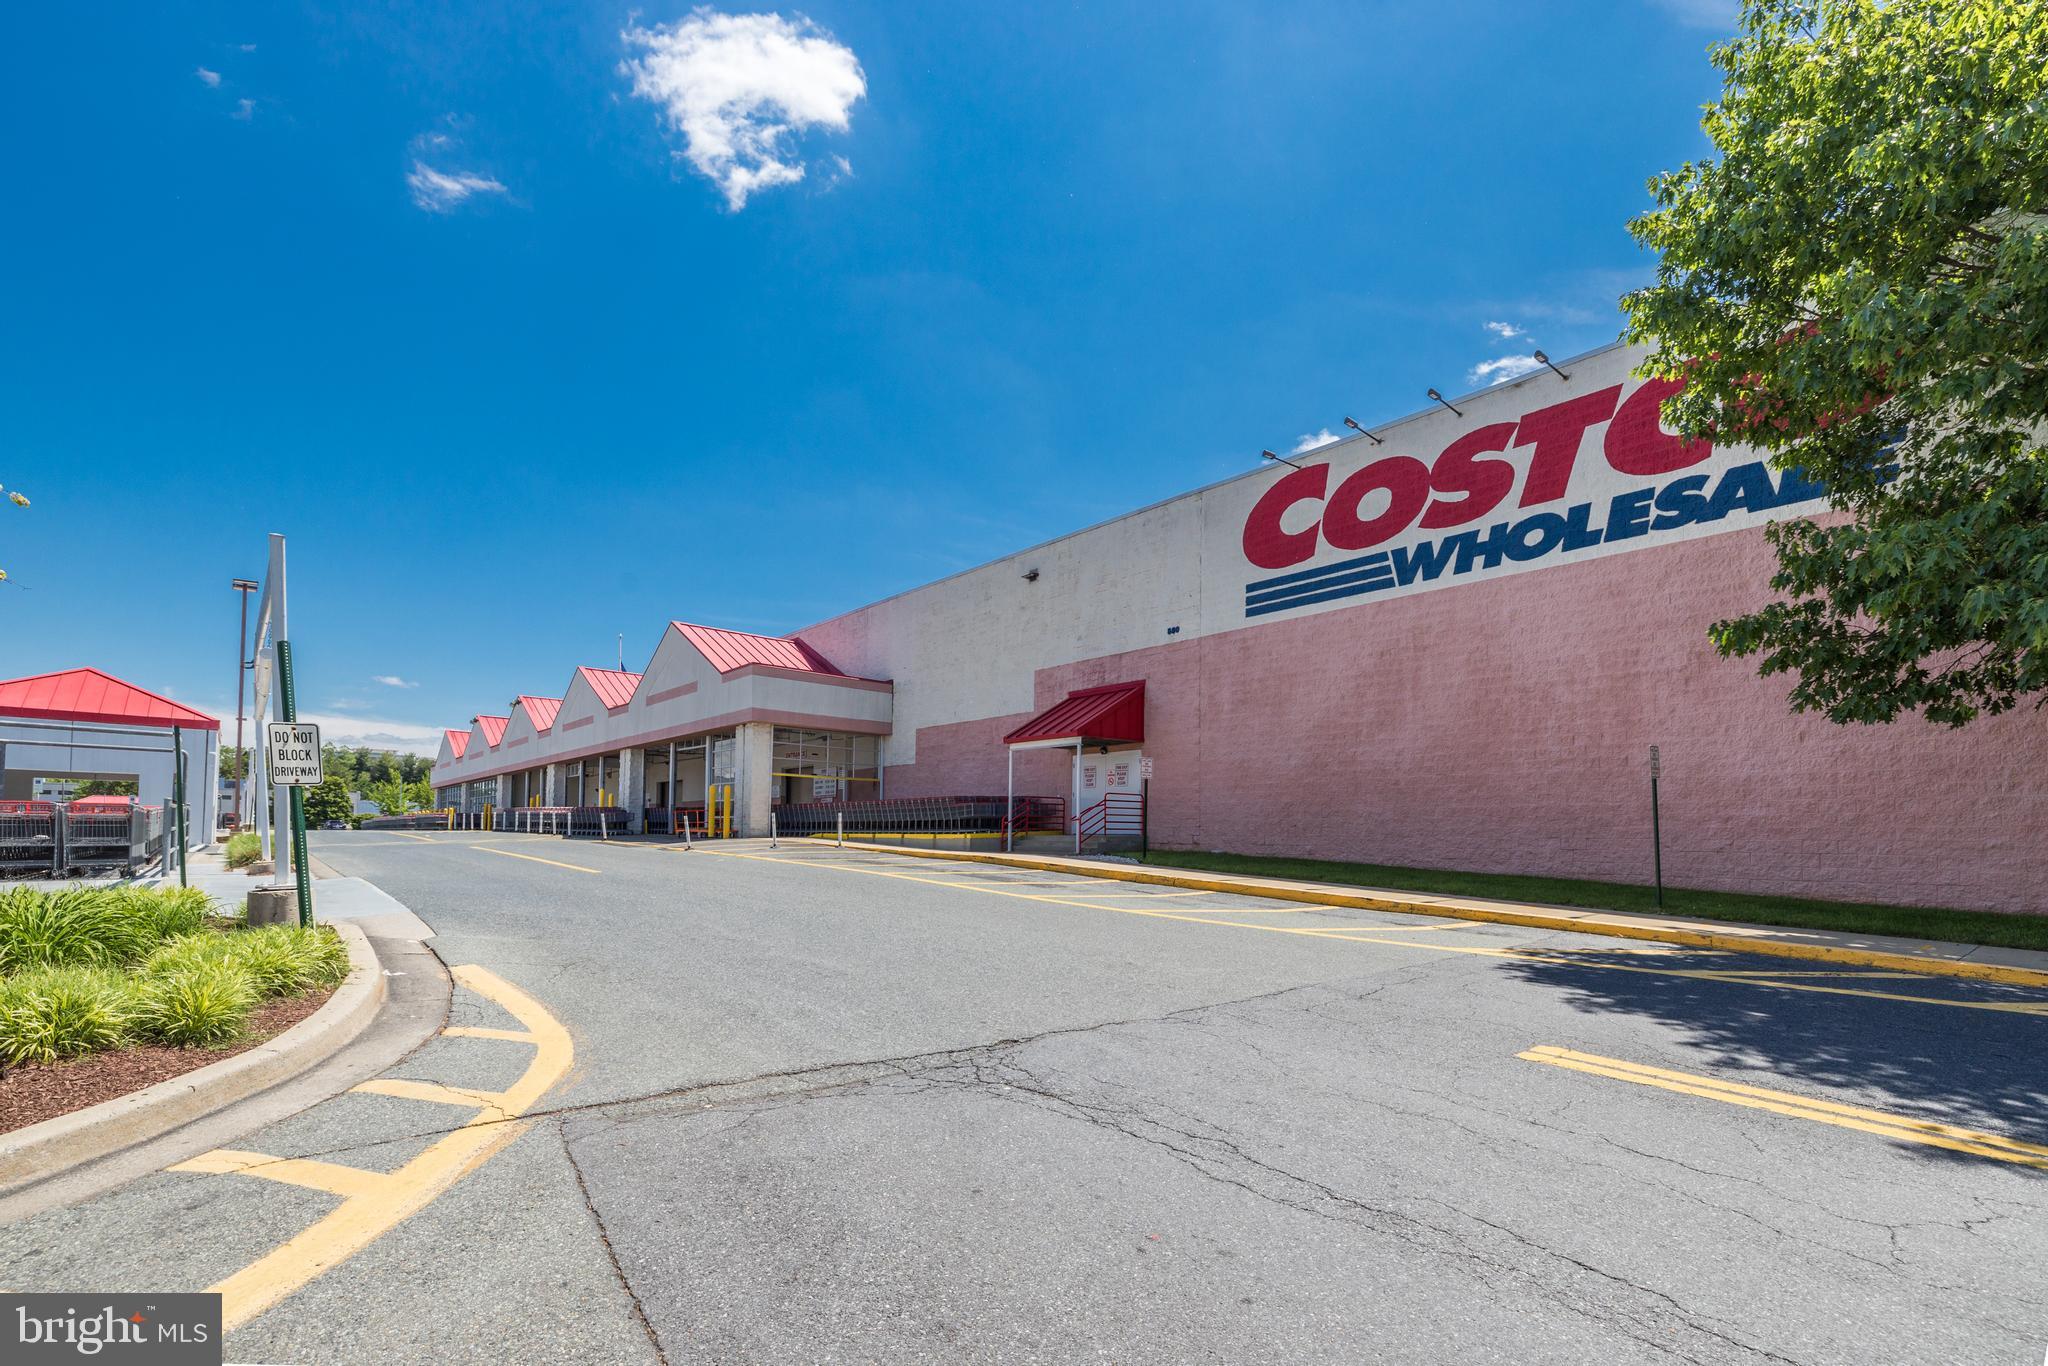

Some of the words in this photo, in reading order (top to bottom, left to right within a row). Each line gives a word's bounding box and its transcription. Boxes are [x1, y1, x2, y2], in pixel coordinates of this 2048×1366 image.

[1243, 322, 1900, 570] COSTC
[274, 731, 289, 743] DO
[293, 731, 313, 744] NOT
[278, 749, 312, 761] BLOCK
[274, 766, 318, 777] DRIVEWAY
